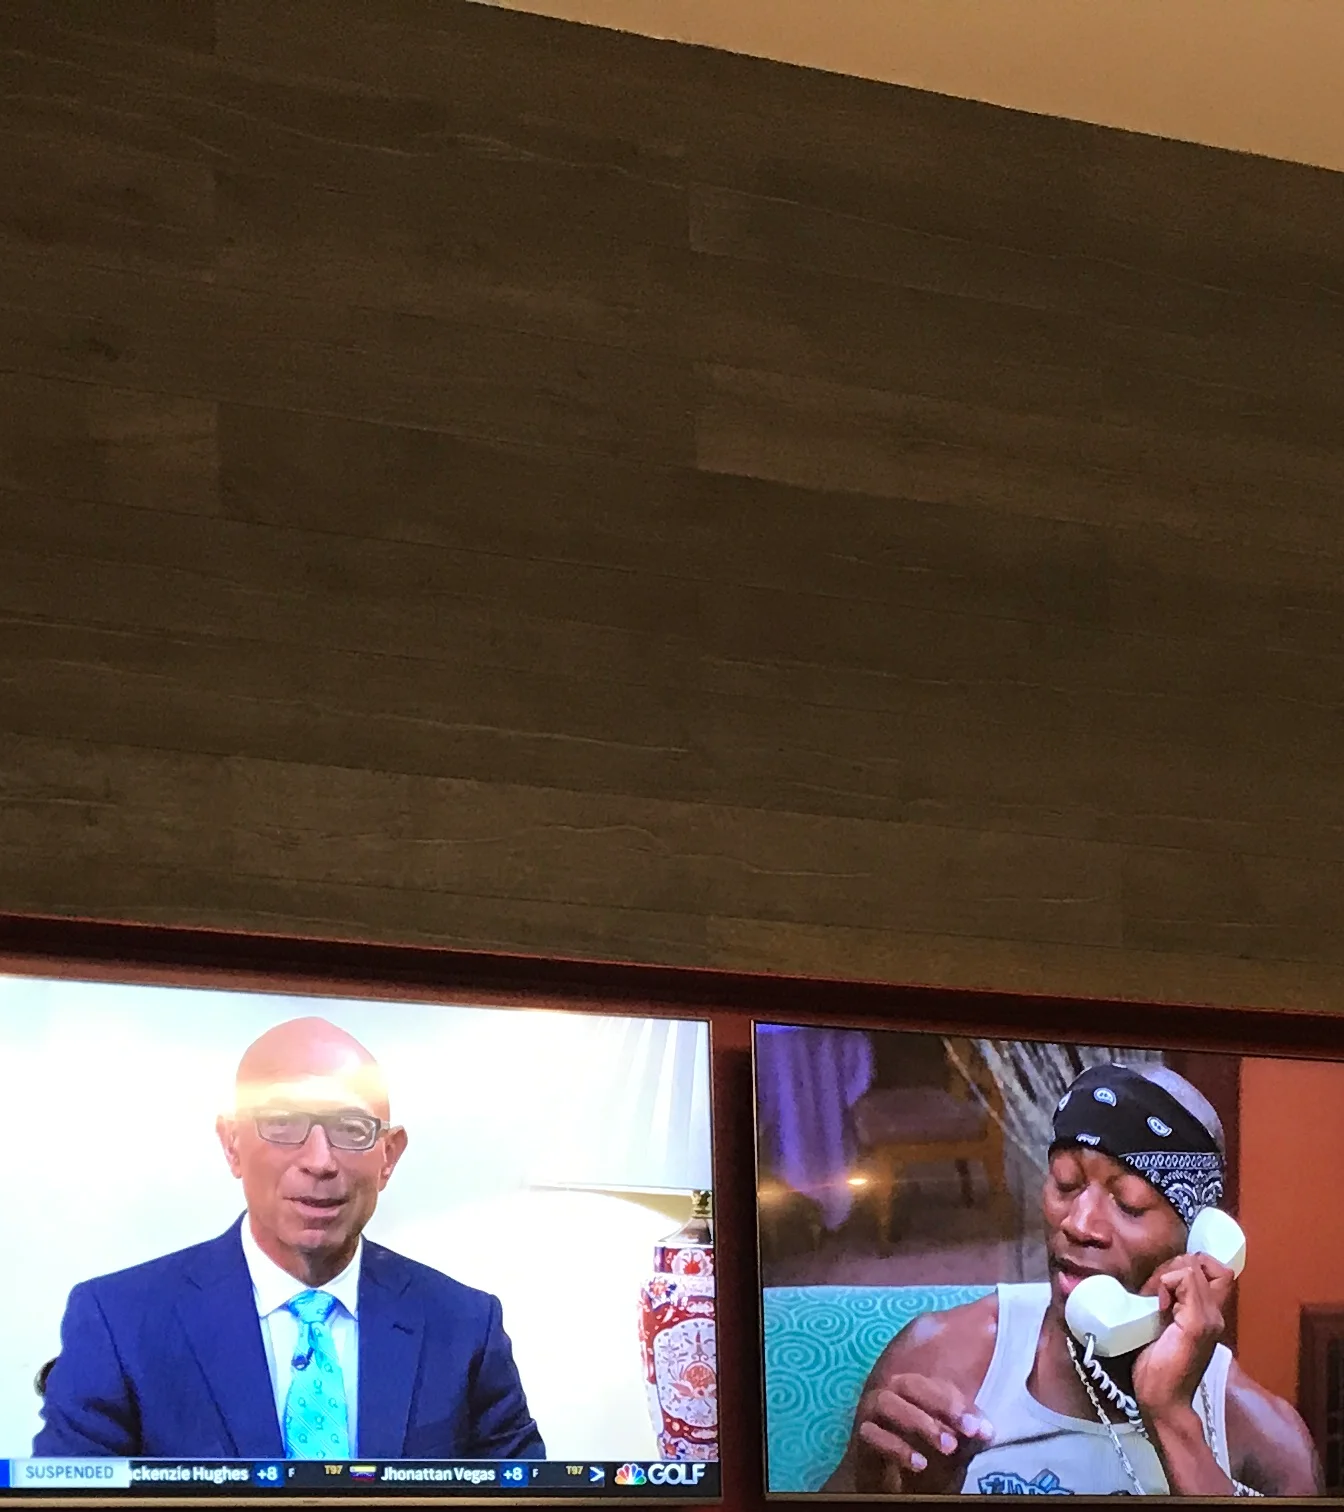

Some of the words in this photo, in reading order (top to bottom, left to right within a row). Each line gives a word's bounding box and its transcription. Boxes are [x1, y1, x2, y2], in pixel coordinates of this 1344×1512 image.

[25, 1465, 114, 1479] SUSPENDED
[192, 1466, 249, 1484] Hughes
[256, 1466, 278, 1481] +8
[288, 1468, 295, 1478] F
[324, 1465, 343, 1475] T97
[381, 1466, 452, 1482] Jhonattan
[453, 1467, 495, 1484] Vegas
[503, 1467, 523, 1481] +8
[532, 1469, 538, 1477] F
[566, 1465, 584, 1475] T97
[648, 1463, 706, 1485] GOLF
